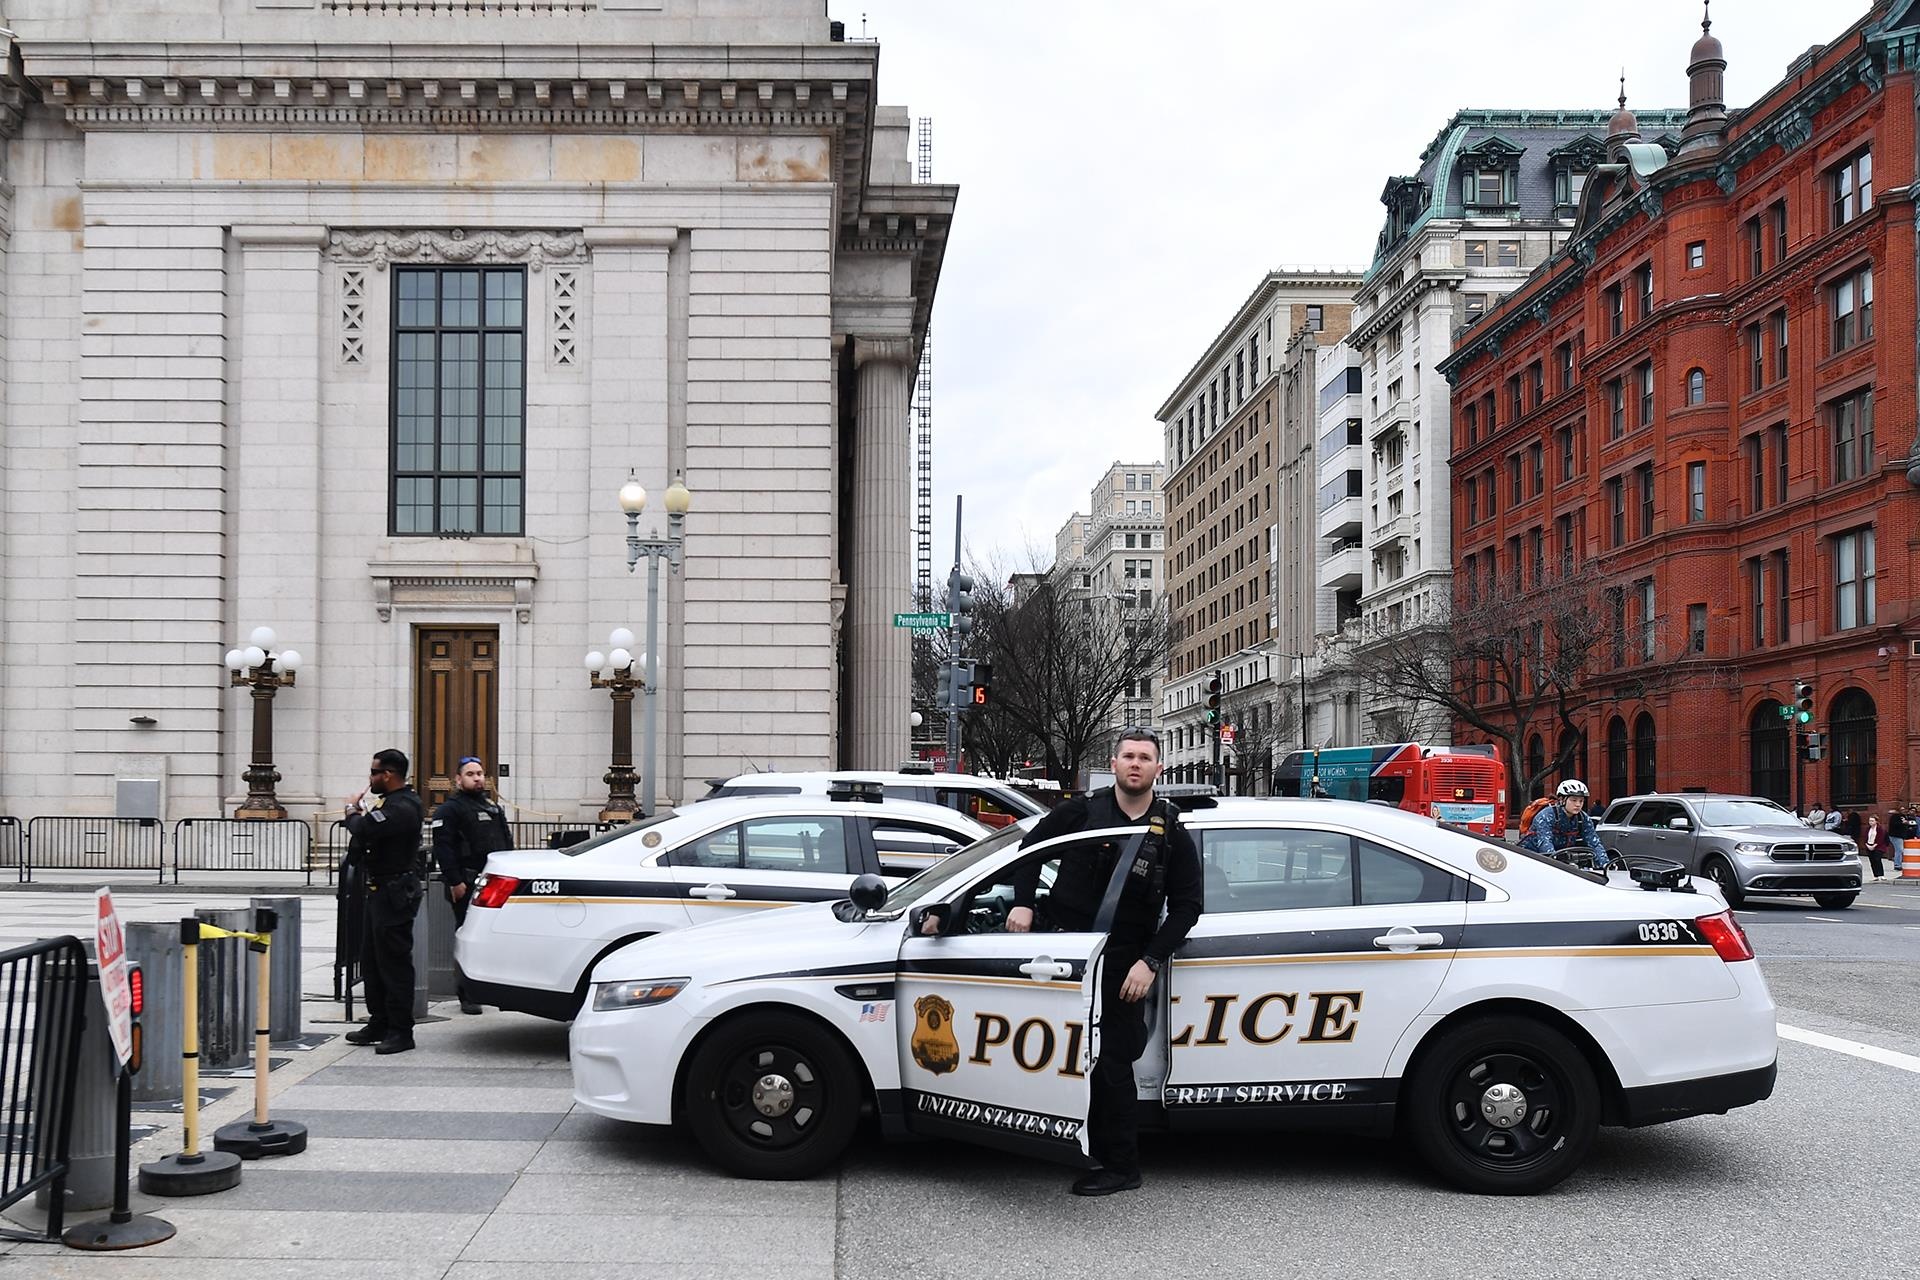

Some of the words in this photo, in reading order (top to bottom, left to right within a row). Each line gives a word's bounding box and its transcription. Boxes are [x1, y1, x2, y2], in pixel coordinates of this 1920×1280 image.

[897, 615, 938, 627] Pennsylvania
[912, 627, 932, 635] 1500
[975, 687, 985, 704] 15
[1455, 789, 1464, 797] 32
[531, 881, 560, 893] 0334
[1638, 922, 1679, 941] 0336
[917, 1094, 980, 1121] UNITED
[981, 1106, 1050, 1135] STATES
[1234, 1082, 1347, 1103] SERVICE
